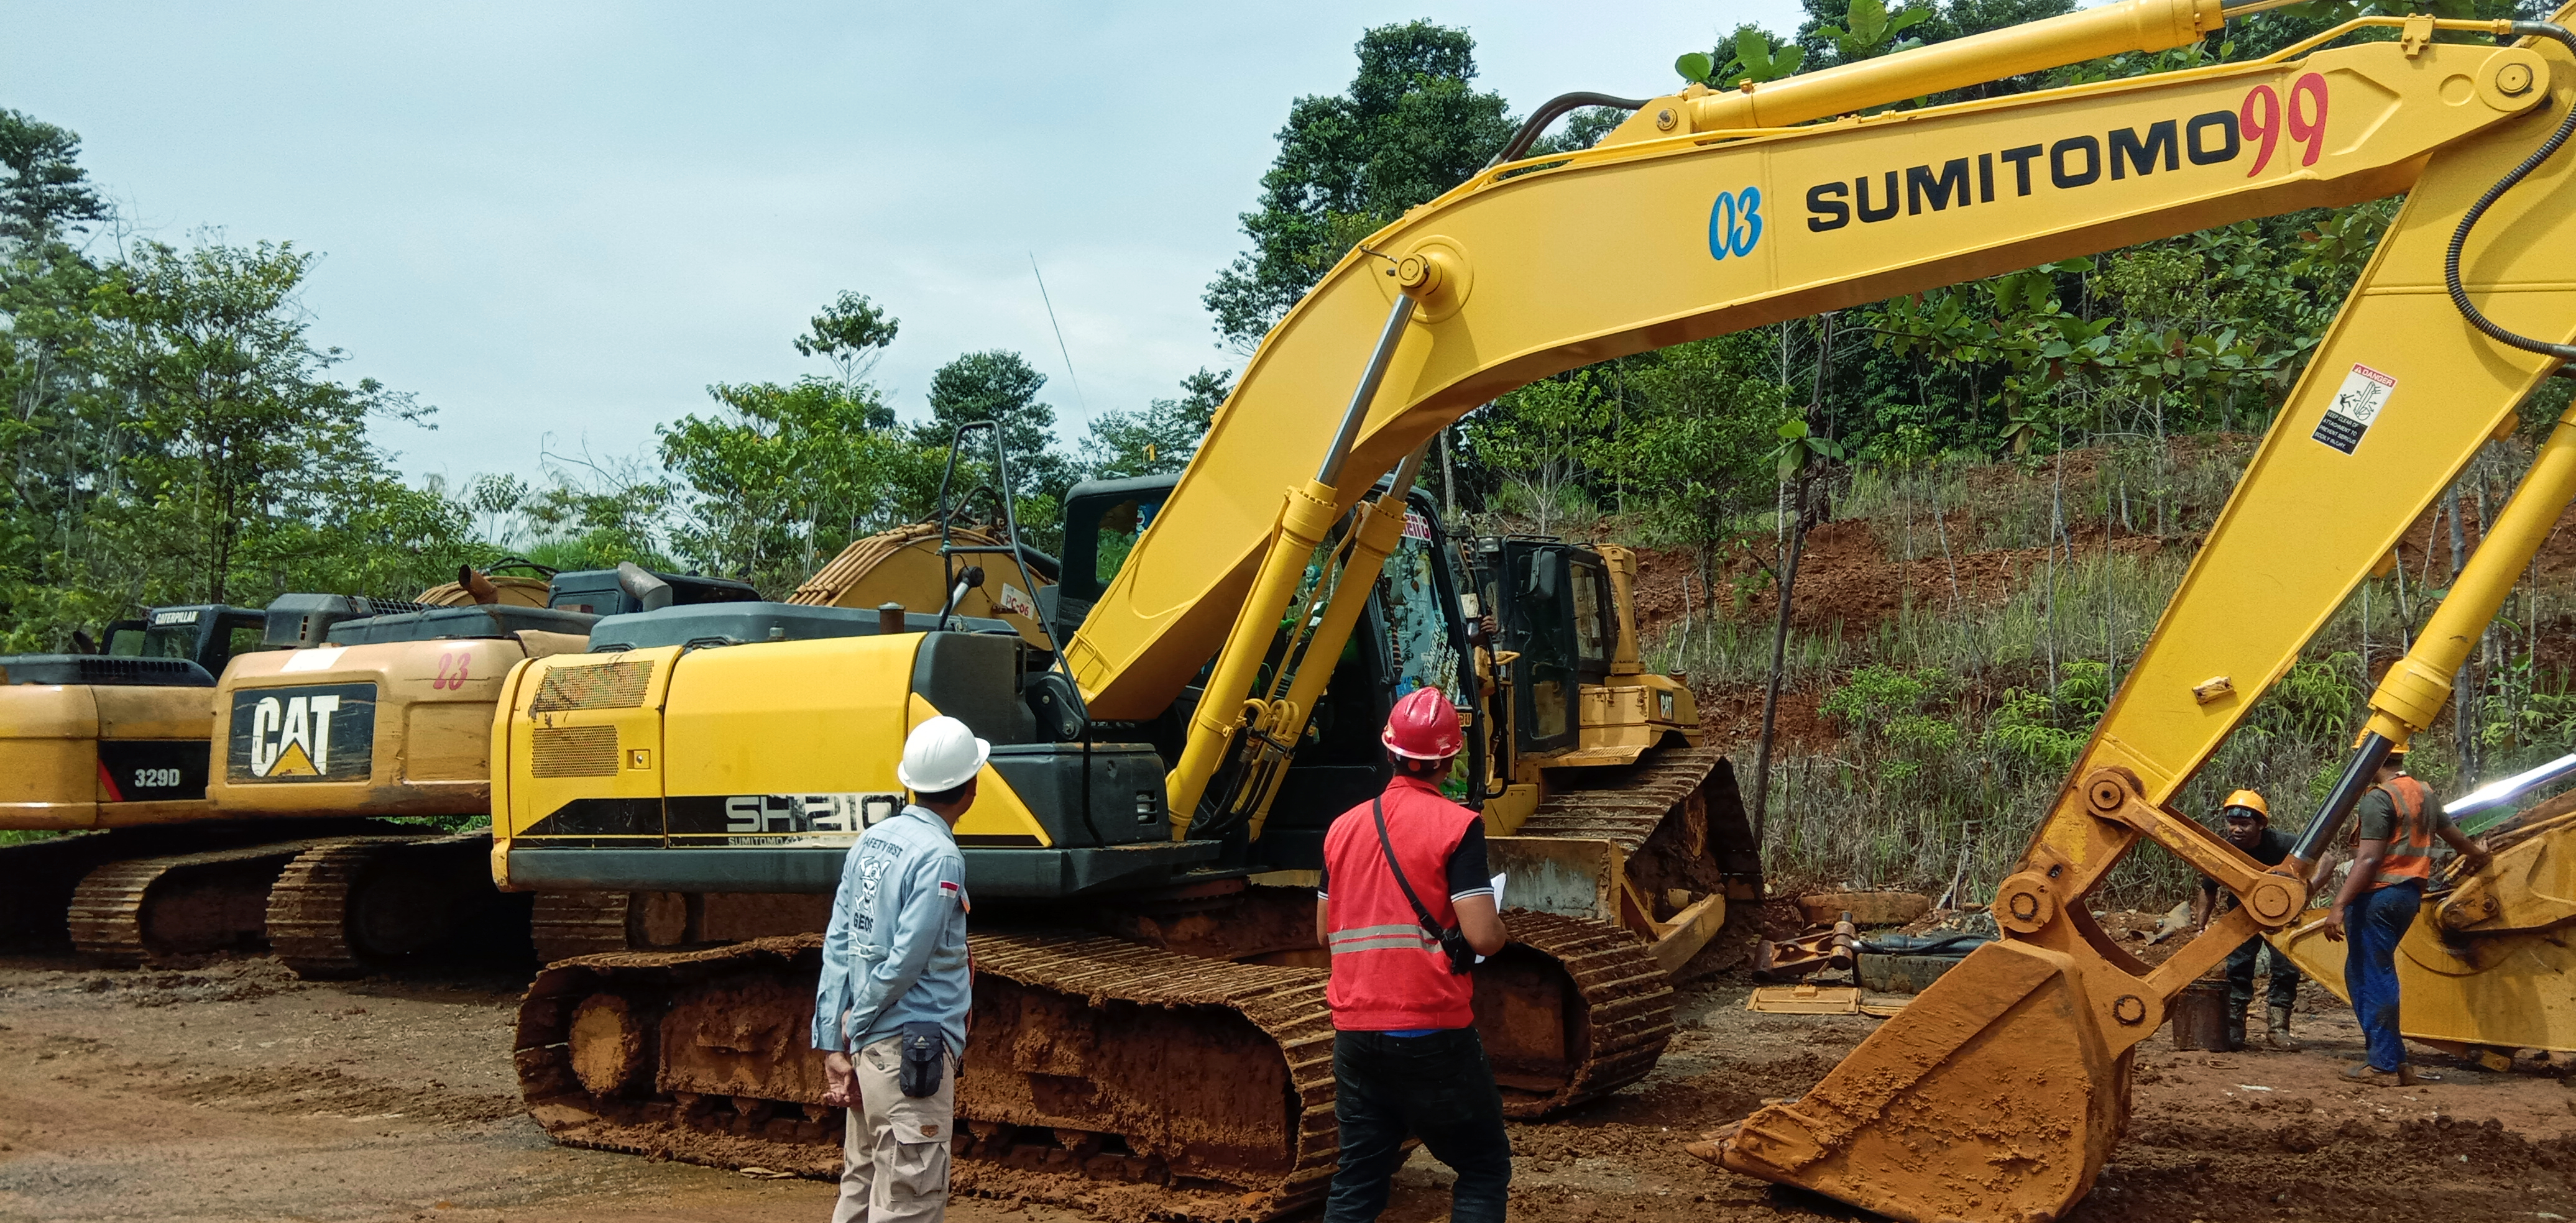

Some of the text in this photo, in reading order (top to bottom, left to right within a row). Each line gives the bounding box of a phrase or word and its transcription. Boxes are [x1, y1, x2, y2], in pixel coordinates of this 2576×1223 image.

[2239, 73, 2329, 177] 99
[1806, 109, 2240, 232] SUMITOMO
[1708, 185, 1764, 260] 03
[2362, 369, 2393, 387] DANGER
[2322, 418, 2350, 433] ATTACHMENT
[2338, 416, 2352, 425] CLEAR
[2319, 425, 2338, 436] PREVENT
[155, 611, 199, 625] CATERPILLAR
[433, 653, 471, 690] 23
[1660, 694, 1672, 719] CAT
[251, 695, 339, 777] CAT
[134, 768, 180, 787] 329D
[728, 836, 783, 846] SUMITOMO
